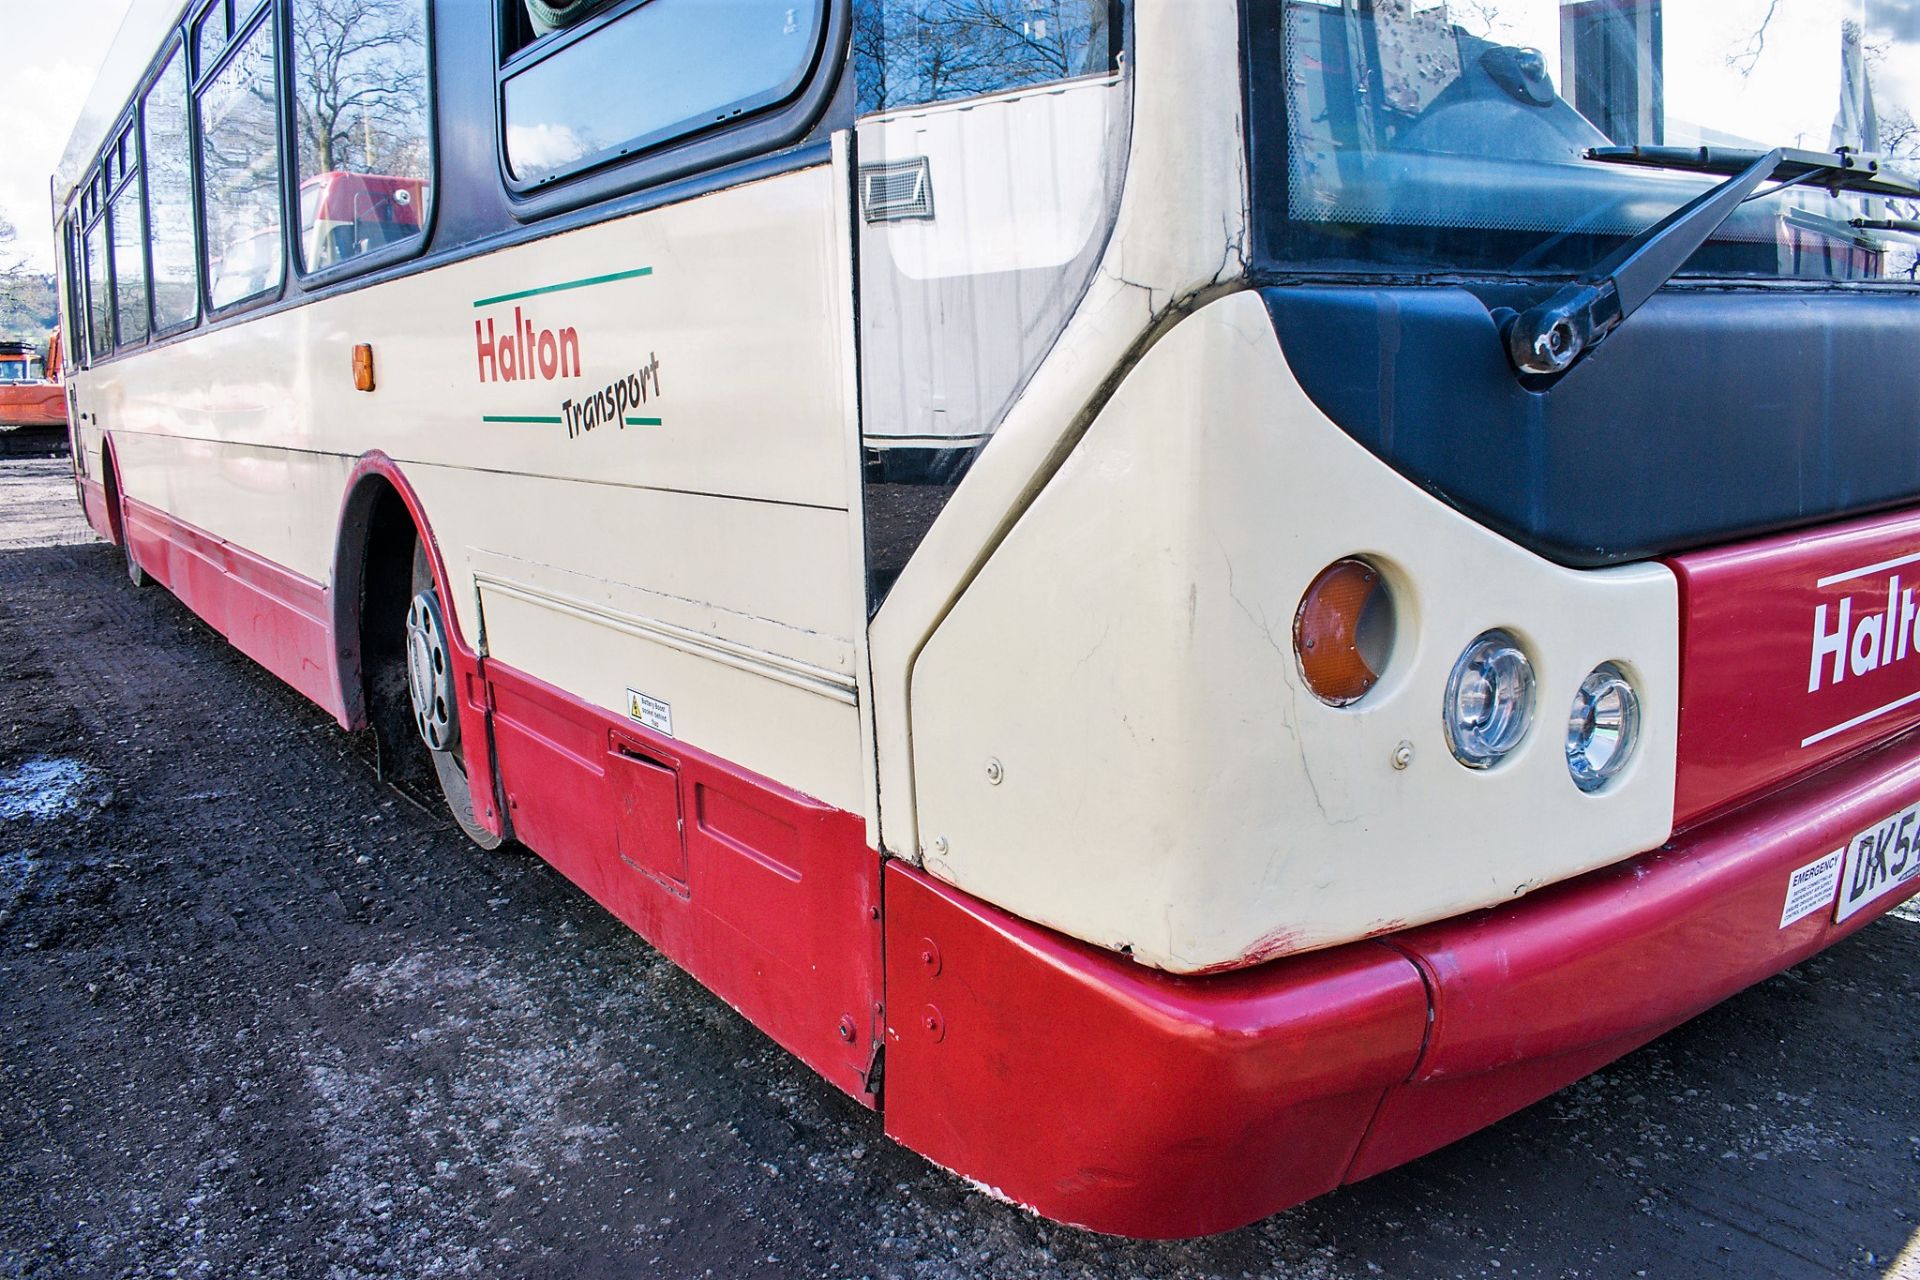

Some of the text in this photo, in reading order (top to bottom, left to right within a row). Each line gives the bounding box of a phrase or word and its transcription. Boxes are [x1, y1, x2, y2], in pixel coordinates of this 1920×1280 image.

[475, 306, 581, 383] Halton
[562, 351, 660, 439] Transport
[1808, 575, 1920, 693] Halt
[1792, 854, 1840, 887] EMERGENCY
